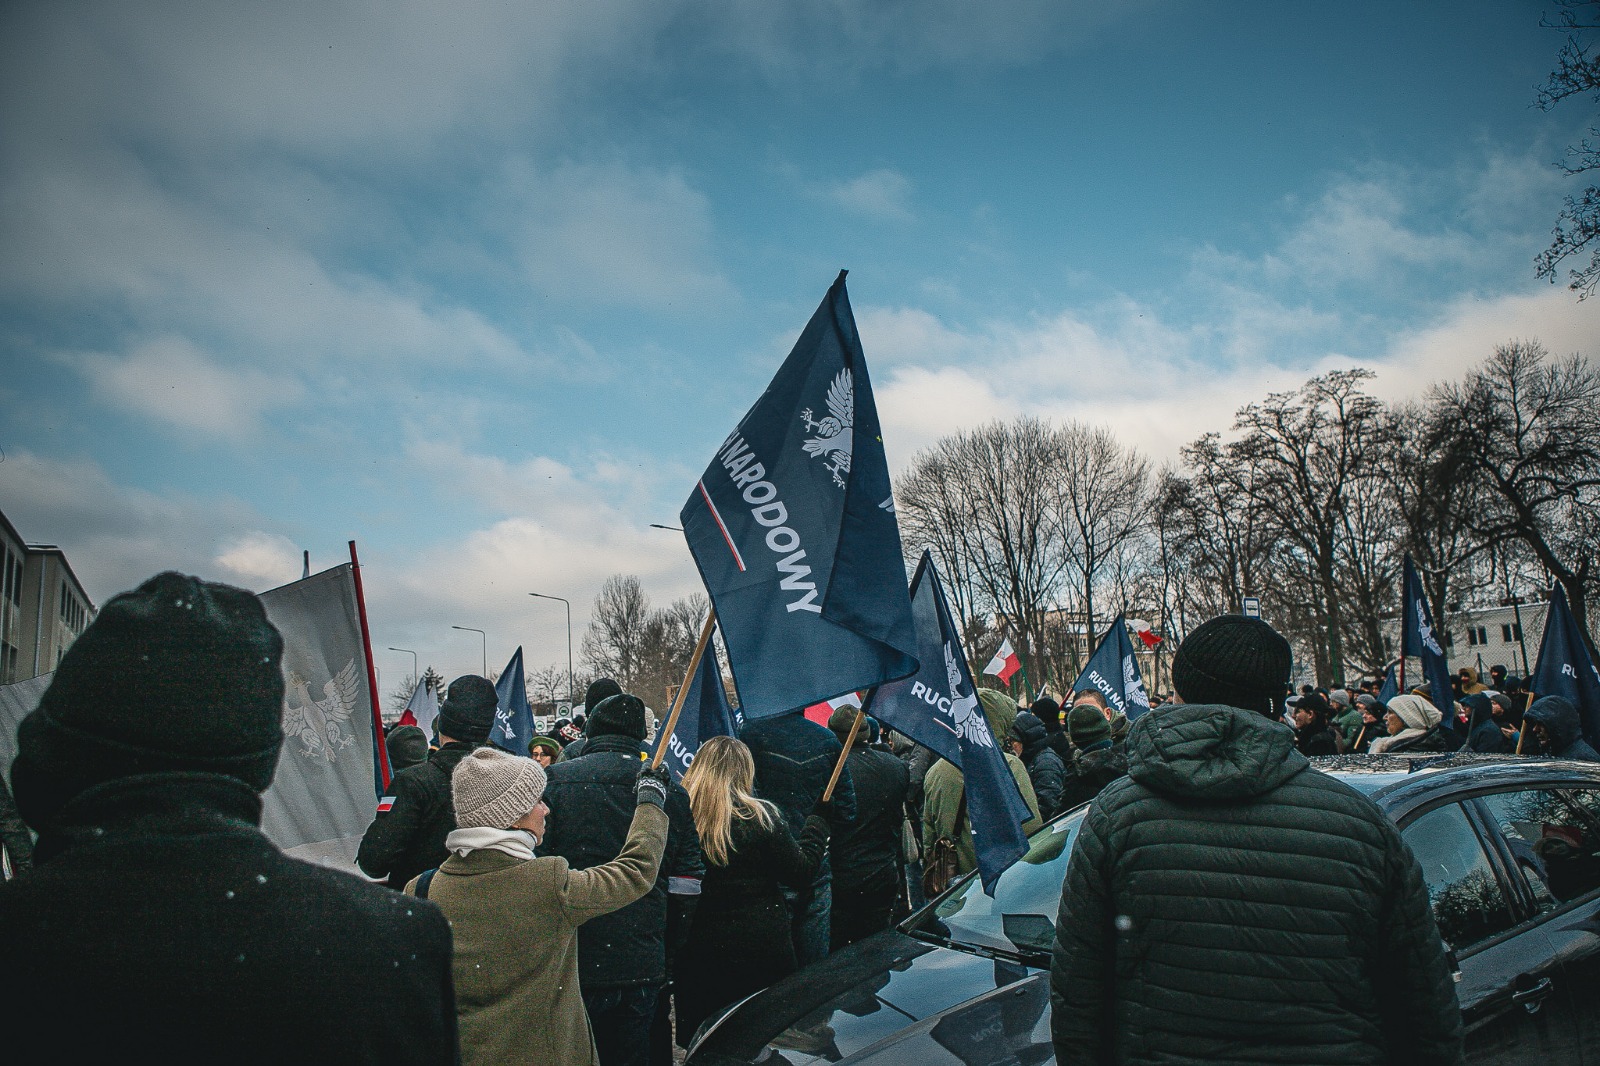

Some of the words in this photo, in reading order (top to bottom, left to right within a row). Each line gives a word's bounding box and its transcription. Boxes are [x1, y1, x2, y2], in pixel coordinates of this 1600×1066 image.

[720, 437, 822, 613] NARODOWY
[911, 681, 955, 717] RUC
[1088, 670, 1113, 695] RUCH
[669, 732, 696, 768] RUC
